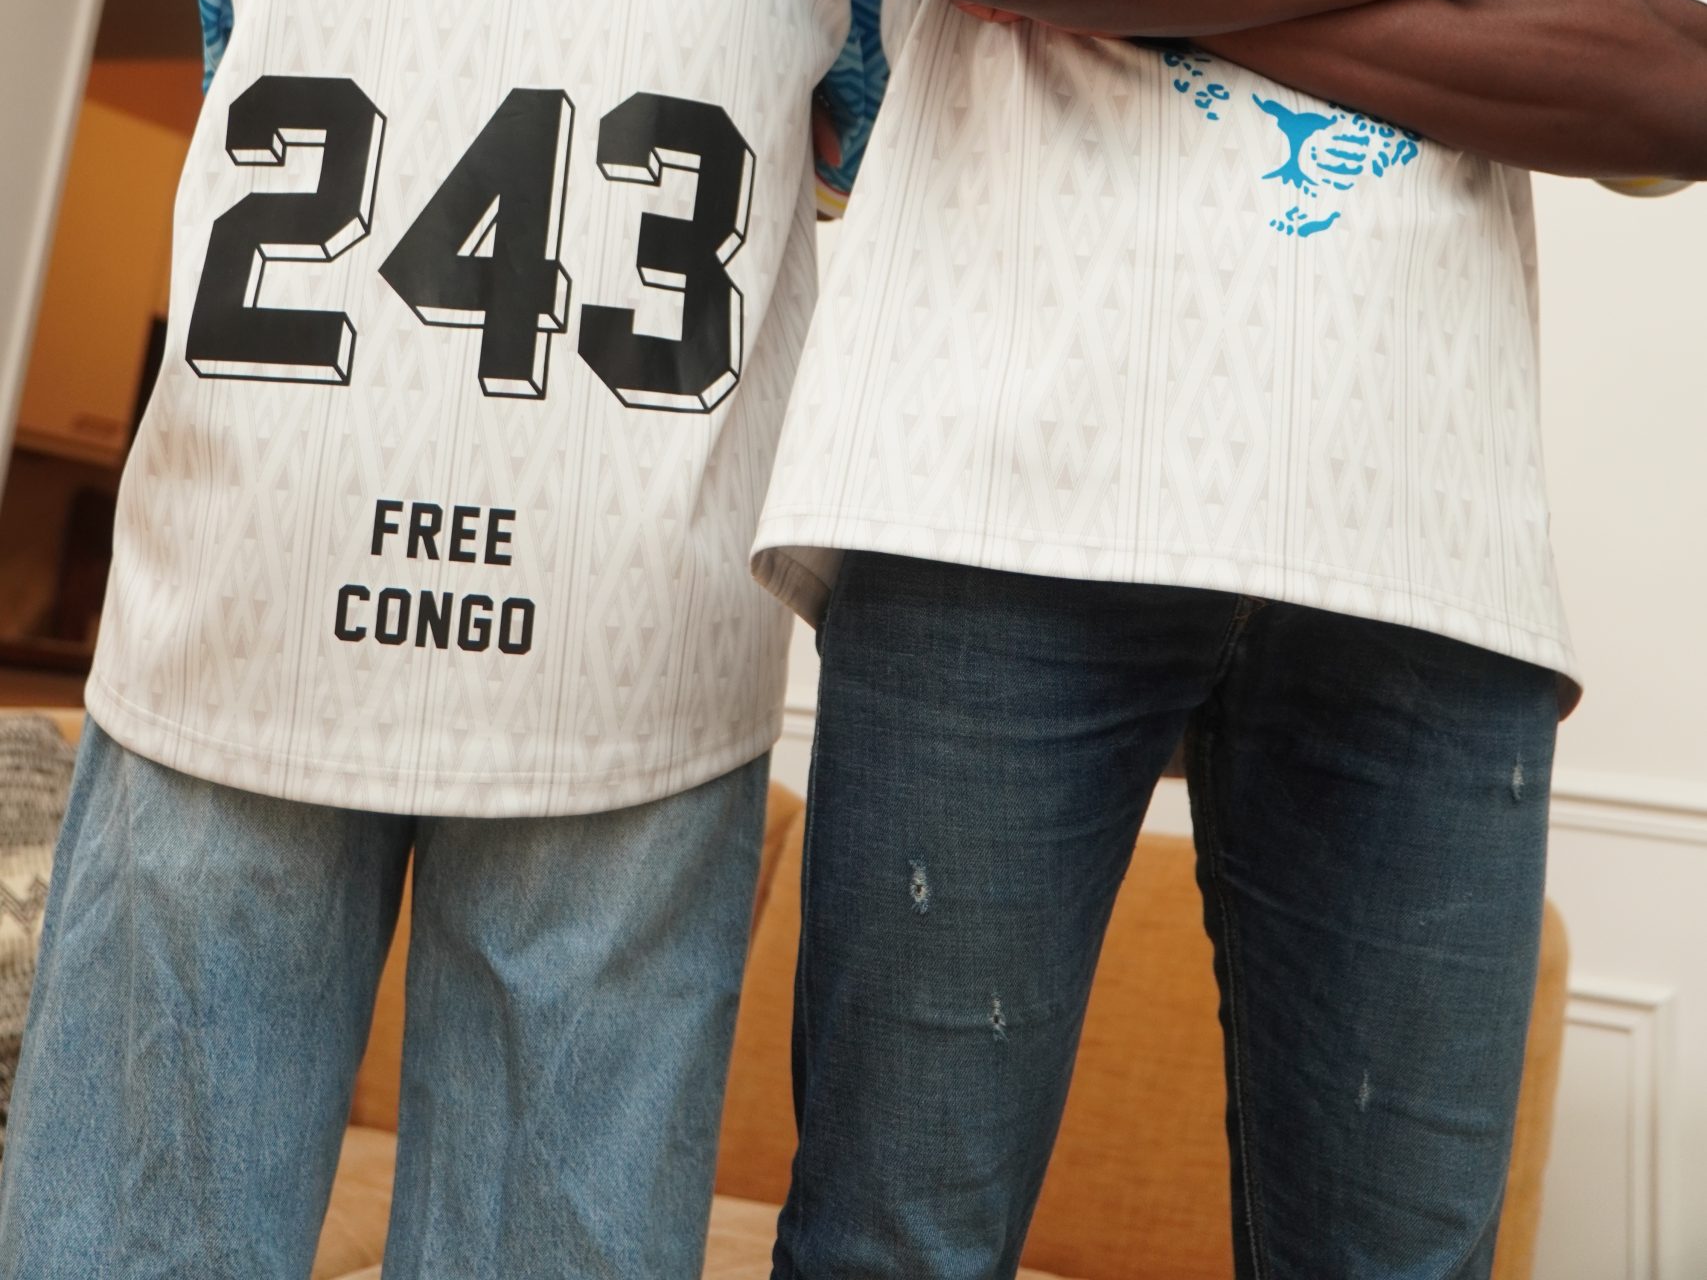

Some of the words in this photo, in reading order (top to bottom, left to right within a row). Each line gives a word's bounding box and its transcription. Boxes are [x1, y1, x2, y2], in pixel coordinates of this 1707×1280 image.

[186, 75, 757, 415] 243
[371, 499, 516, 566] FREE
[334, 584, 535, 655] CONGO
